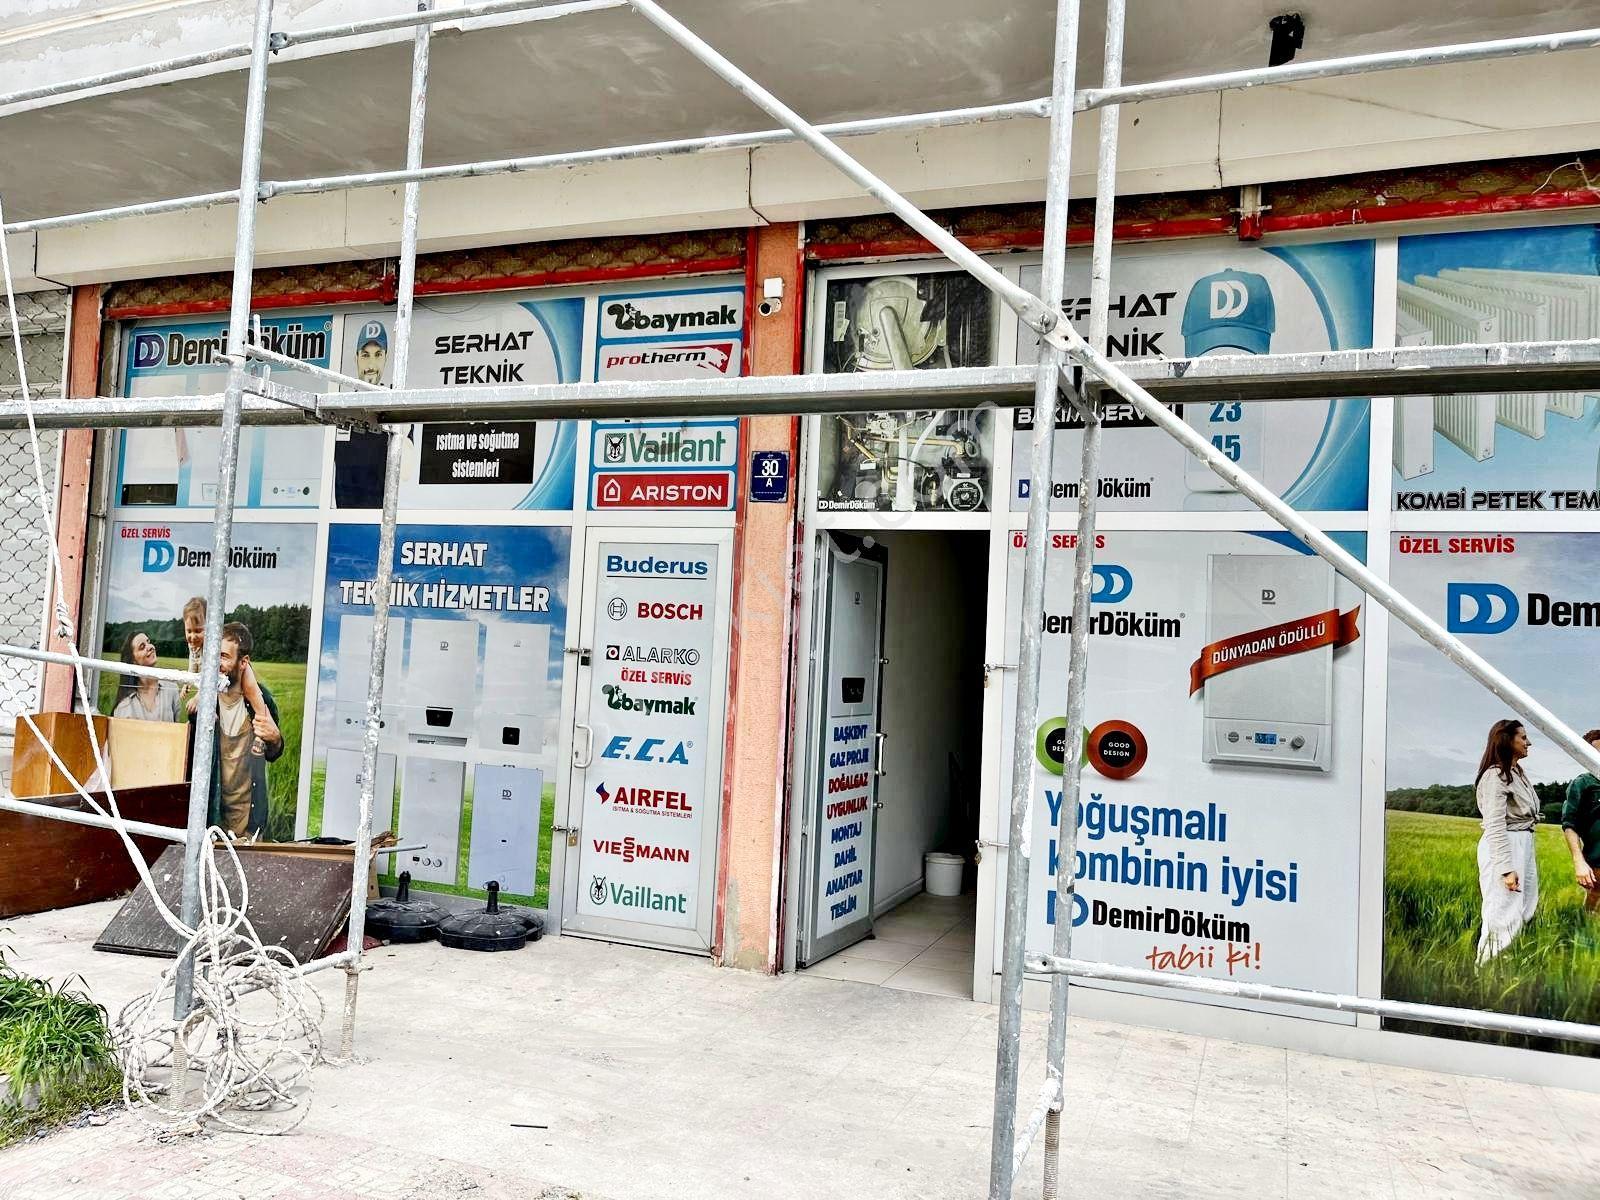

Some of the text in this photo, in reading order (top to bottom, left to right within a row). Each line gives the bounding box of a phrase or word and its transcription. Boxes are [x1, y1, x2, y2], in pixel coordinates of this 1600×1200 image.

[1061, 292, 1177, 320] ERHAT
[635, 305, 736, 331] baymak
[435, 331, 533, 354] SERHAT
[607, 350, 706, 369] protherm
[440, 358, 524, 384] TEKNİK
[1210, 401, 1241, 422] 23
[436, 429, 519, 452] ısıtma ve soğutma
[629, 431, 726, 463] Vaillant
[452, 459, 500, 477] sistemleri
[762, 460, 778, 476] 30
[631, 485, 722, 501] ARISTON
[766, 478, 773, 487] A
[829, 500, 875, 510] DemirDöküm
[1397, 487, 1466, 509] KOMBİ
[1473, 491, 1545, 509] PETEK
[121, 526, 171, 538] ÖZEL SERVİS
[1052, 535, 1105, 549] SERS
[400, 542, 488, 568] SERHAT
[1399, 534, 1515, 554] ÖZEL SERVİS
[178, 546, 277, 568] Demöküm
[607, 555, 708, 575] Buderus
[339, 578, 550, 612] TEKİK HİZMETLER
[638, 603, 703, 620] BOSCH
[1528, 593, 1600, 627] Dem
[1212, 621, 1326, 665] DÜNYADAN ÖDÜLLÜ
[622, 646, 700, 665] ALARKO
[621, 667, 692, 685] ÖZEL SERVİS
[622, 693, 695, 715] baymak
[834, 724, 868, 744] BAŞKENT
[830, 752, 846, 768] GAZ
[828, 772, 868, 794] DOĞALGAZ
[614, 787, 692, 811] AIRFEL
[826, 796, 868, 820] UYGUNLUK
[635, 808, 660, 816] SOĞUTMA
[831, 821, 862, 844] MONTAJ
[834, 846, 857, 868] DAHİL
[826, 870, 863, 897] ANAHTAR
[1221, 856, 1297, 907] iyisi
[610, 882, 687, 913] Vaillant
[831, 894, 857, 920] TESLİM
[1092, 900, 1250, 943] DemirDöküm
[1146, 943, 1261, 975] tabii ki!
